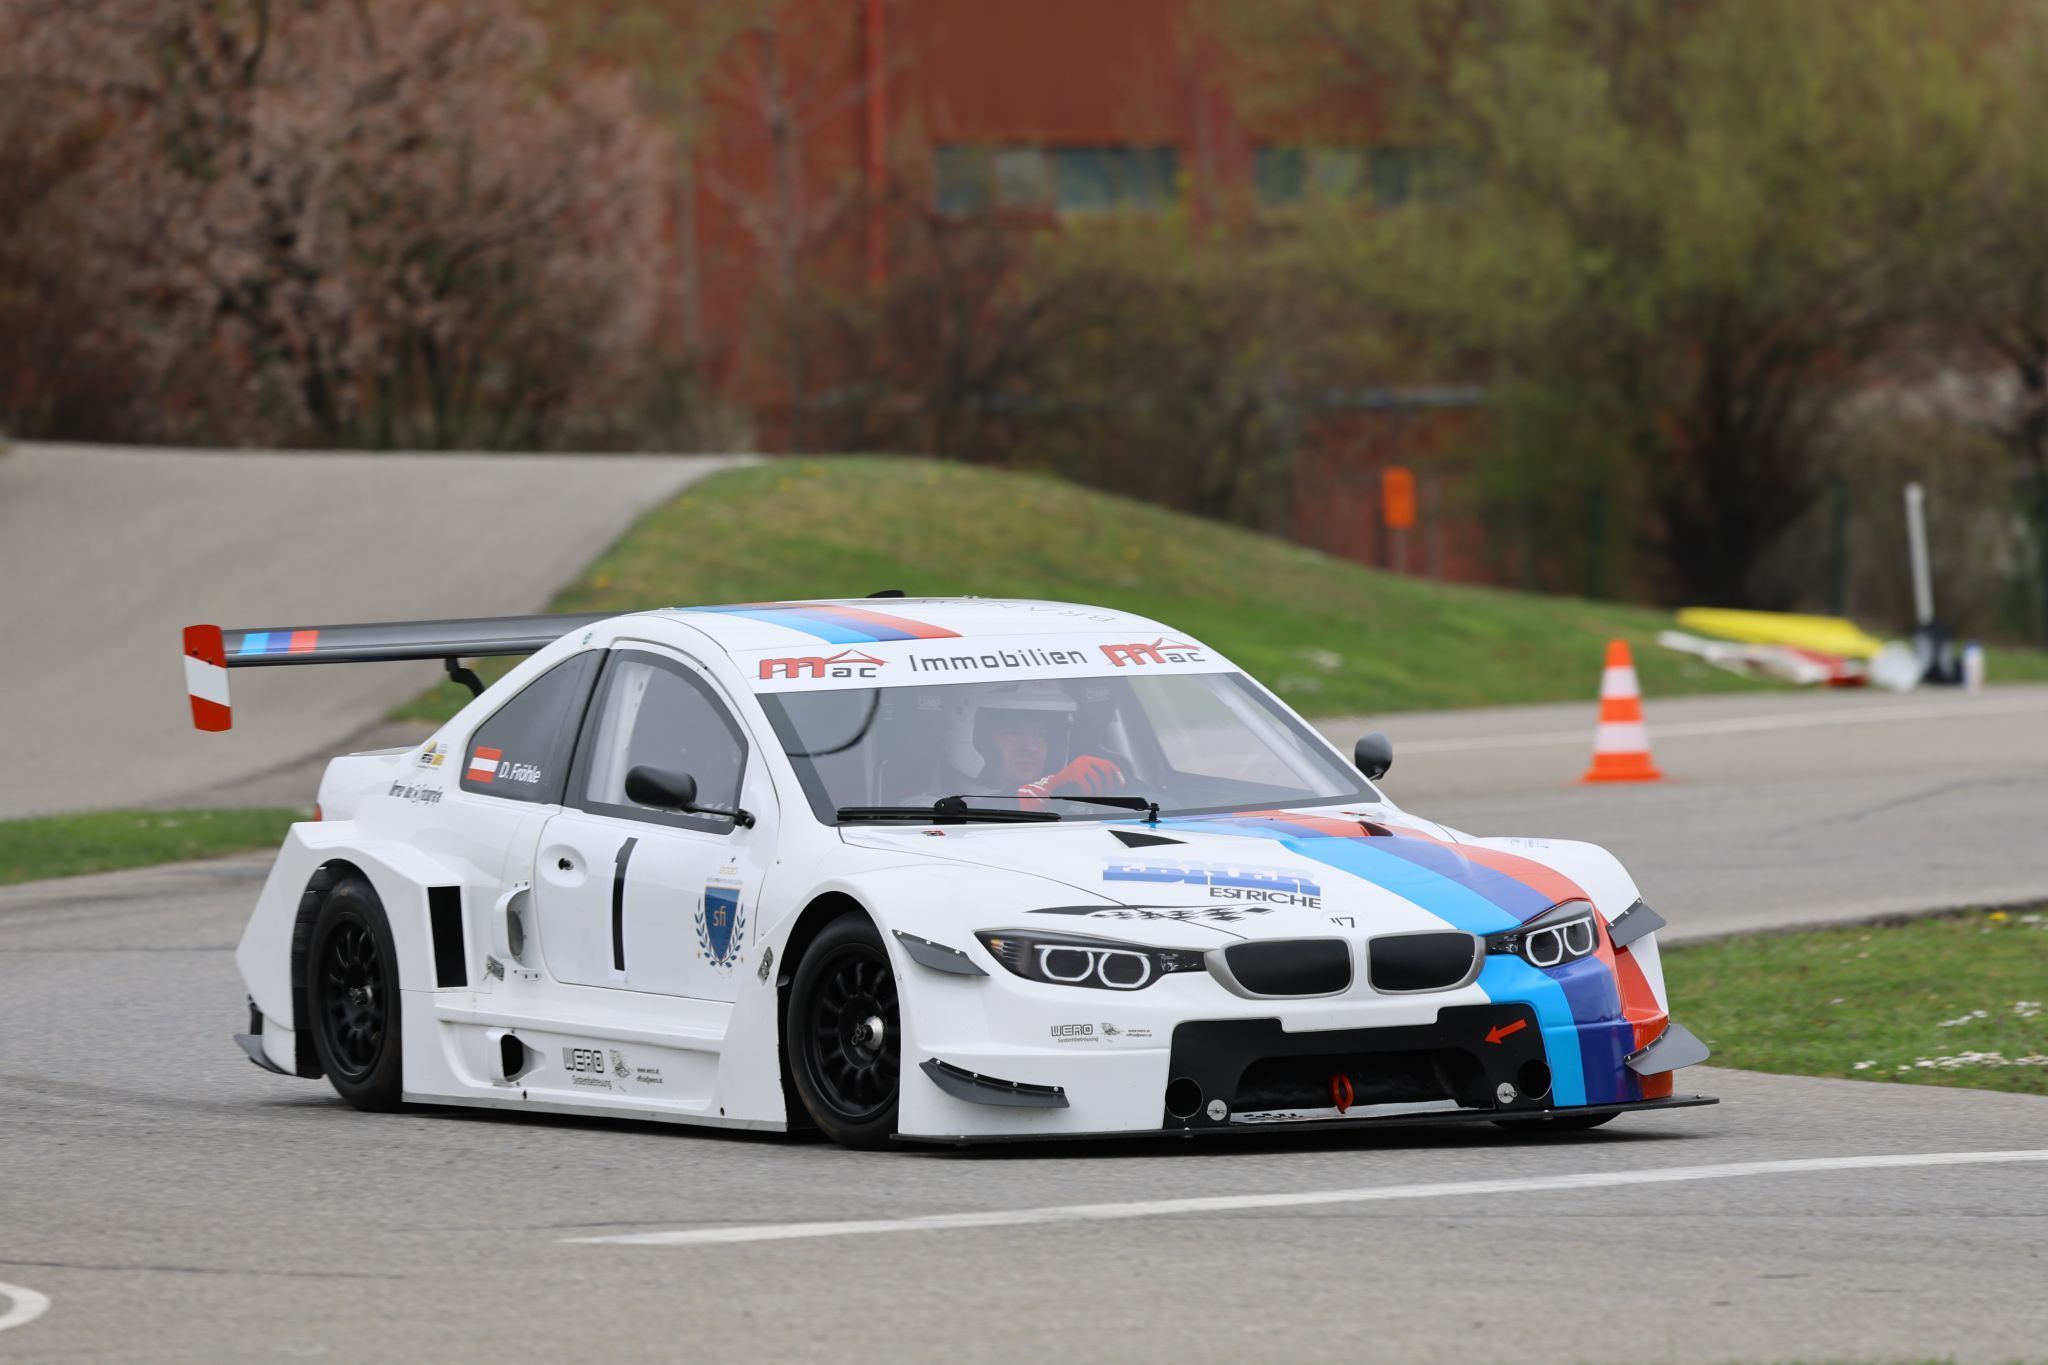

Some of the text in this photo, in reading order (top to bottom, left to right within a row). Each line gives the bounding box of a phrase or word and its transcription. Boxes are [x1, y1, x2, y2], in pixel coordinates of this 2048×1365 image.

[909, 649, 1088, 672] Immobilien
[611, 837, 638, 970] 1
[1209, 887, 1321, 909] ESTRICHE
[713, 905, 726, 927] sfi
[1051, 1023, 1094, 1037] WERO
[562, 1047, 605, 1074] WERO
